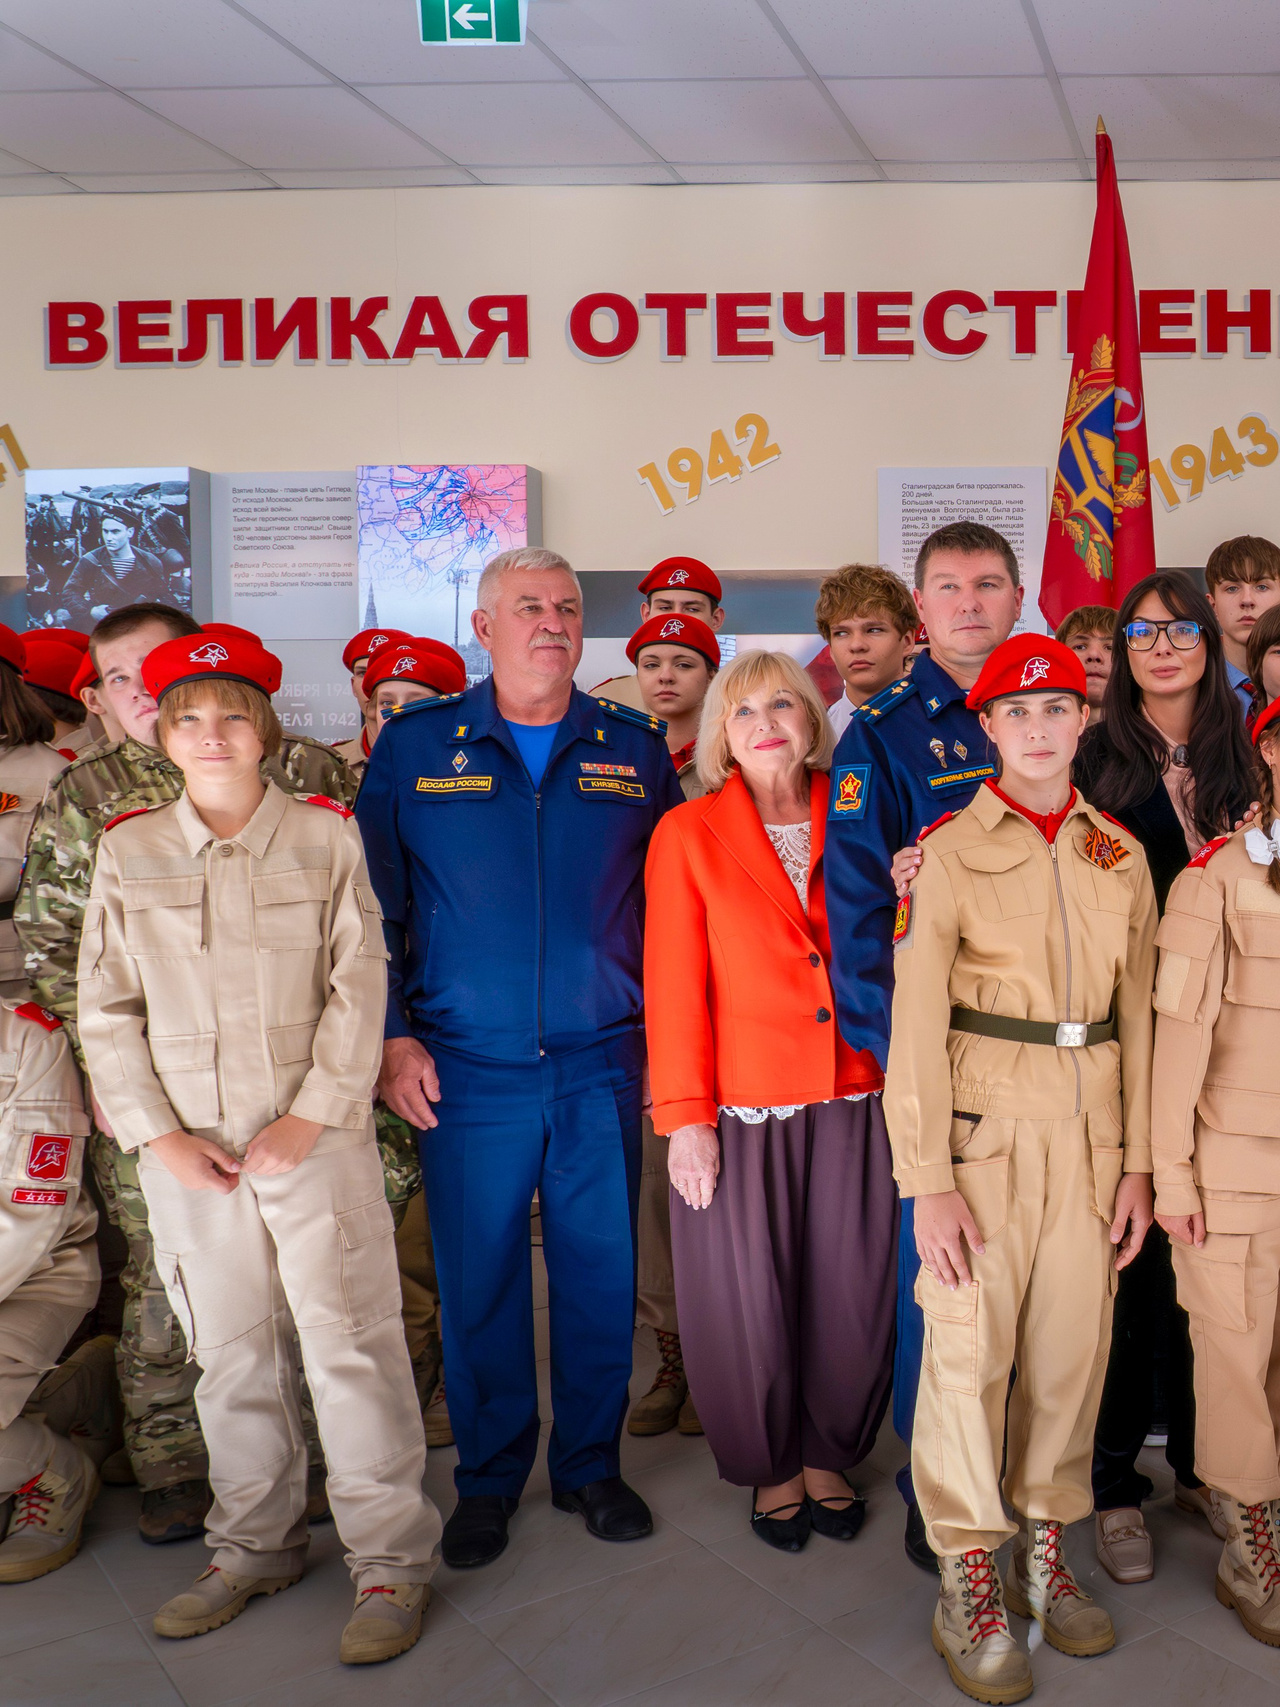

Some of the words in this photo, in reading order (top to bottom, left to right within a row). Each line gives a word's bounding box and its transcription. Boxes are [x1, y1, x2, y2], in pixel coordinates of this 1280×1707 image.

[48, 294, 529, 365] ВЕЛИКАЯ
[637, 413, 781, 511] 1942
[1149, 416, 1279, 508] 1943
[321, 713, 356, 726] 1942
[591, 781, 620, 789] КНЯЗЕВ
